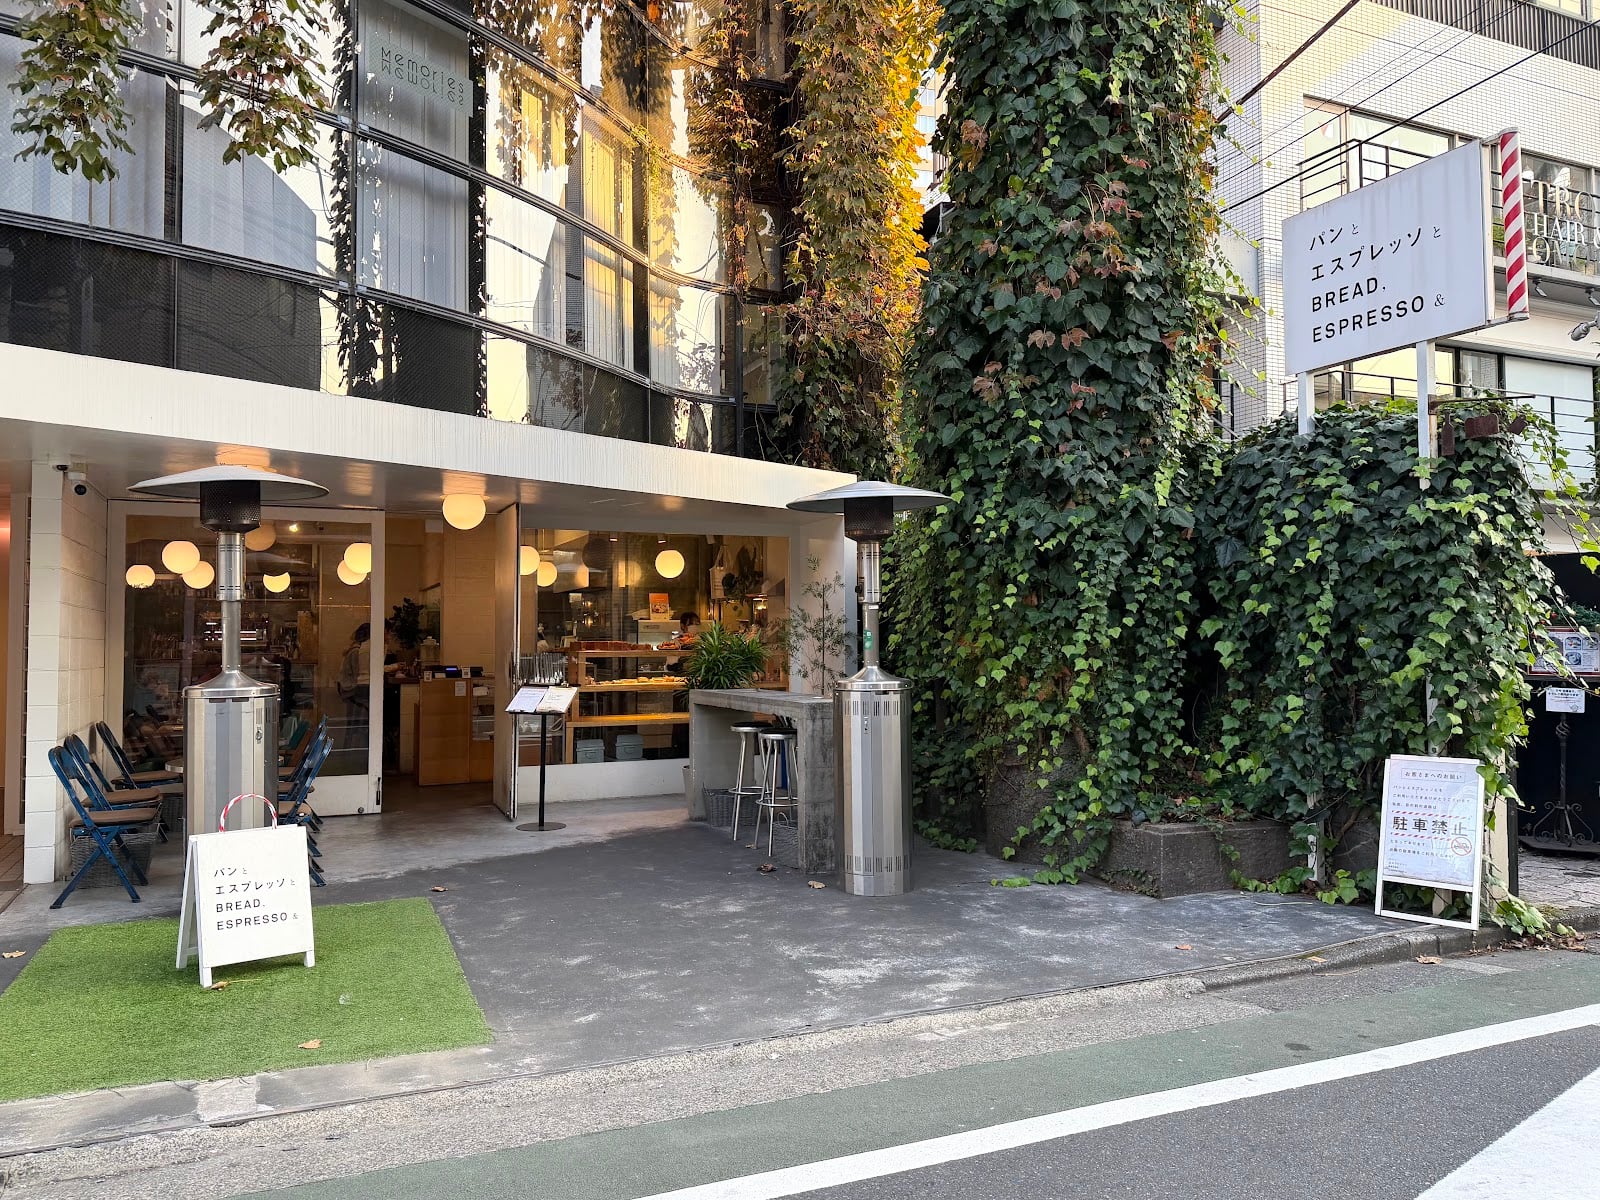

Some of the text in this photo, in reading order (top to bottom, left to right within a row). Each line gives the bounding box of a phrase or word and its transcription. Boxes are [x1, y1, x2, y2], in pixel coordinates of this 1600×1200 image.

[381, 46, 464, 94] Memories
[1309, 223, 1359, 251] パンと
[1533, 212, 1588, 247] HAIR
[1311, 226, 1441, 282] エスプレッソと
[1313, 293, 1446, 343] ESPRESSO &
[1392, 816, 1468, 837] 駐車禁止
[217, 912, 288, 931] ESPRESSO
